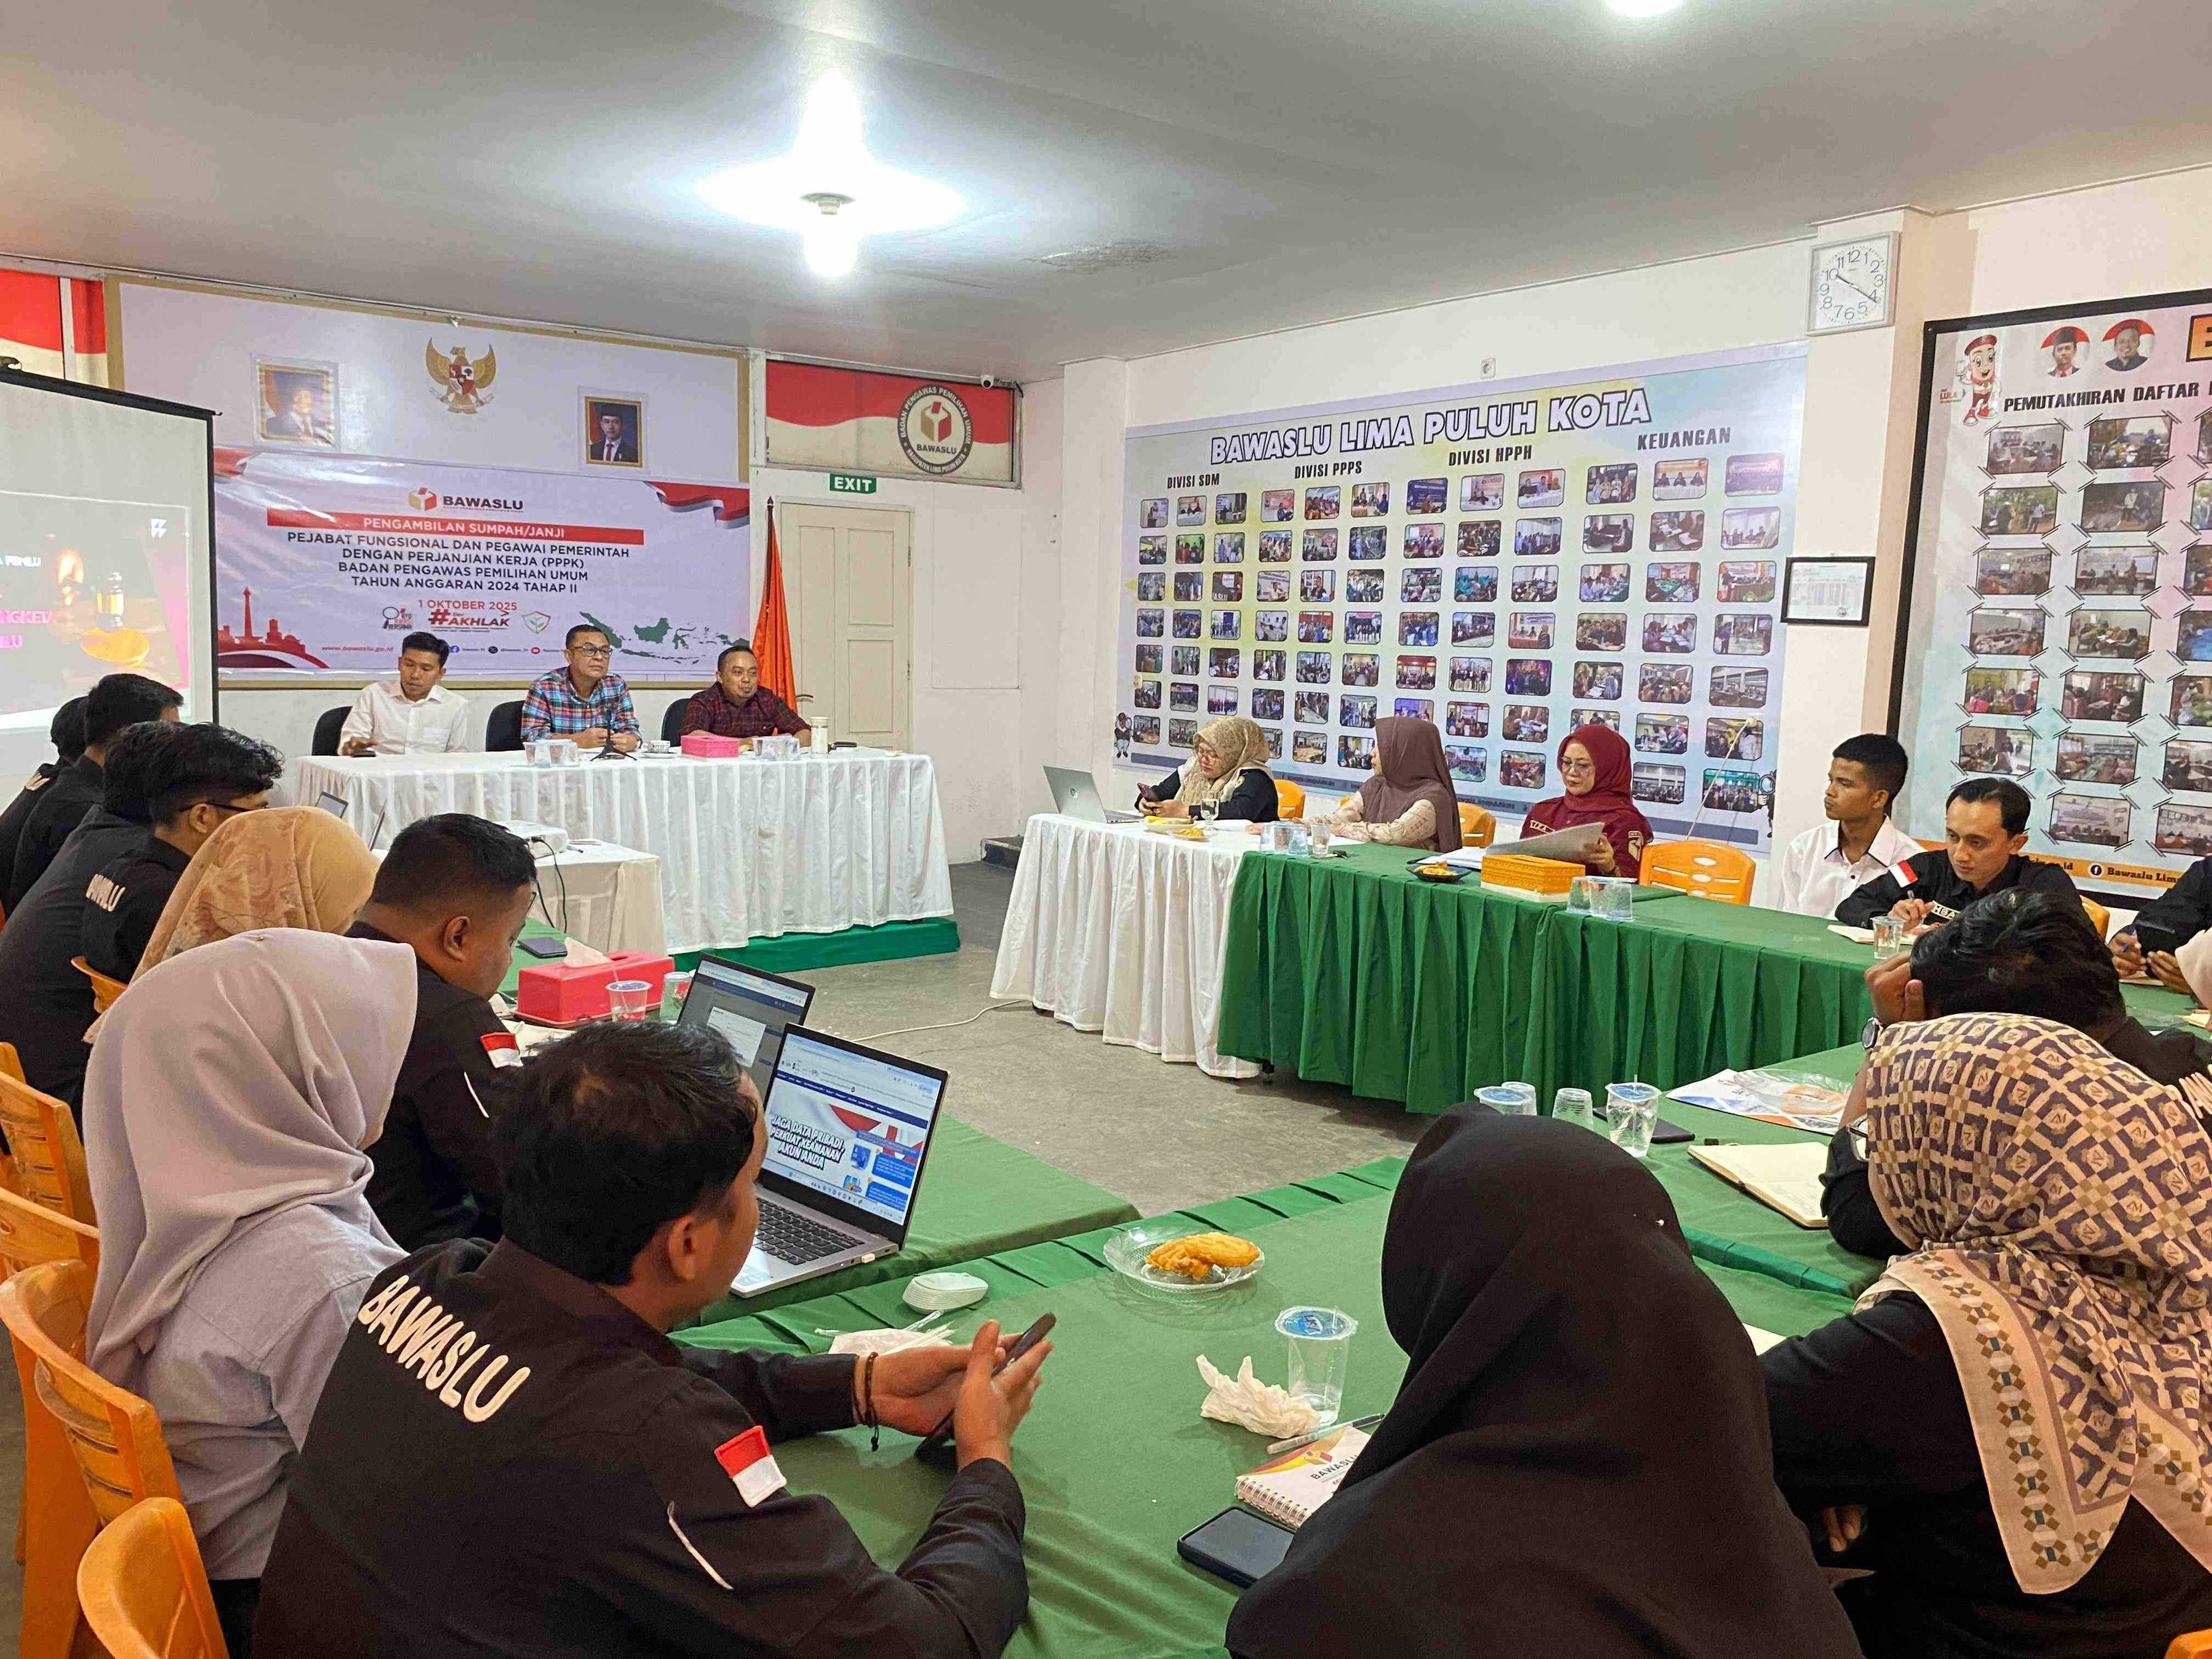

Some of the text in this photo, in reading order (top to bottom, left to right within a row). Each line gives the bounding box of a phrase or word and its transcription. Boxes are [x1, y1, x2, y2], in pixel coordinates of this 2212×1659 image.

[1837, 256, 1844, 269] 11
[1848, 250, 1860, 263] 12
[1865, 252, 1868, 264] 1
[1826, 268, 1839, 281] 10
[1870, 260, 1880, 273] 2
[1874, 274, 1883, 287] 3
[1819, 283, 1830, 296] 9
[1822, 297, 1832, 309] 8
[1858, 301, 1868, 314] 5
[1834, 305, 1843, 318] 7
[1844, 307, 1855, 320] 6
[2004, 388, 2125, 412] PEMUTAKHIRAN
[2133, 382, 2199, 401] DAFTAR
[1210, 387, 1652, 465] BAWASLU LIMA PULUH KOTA
[1637, 426, 1731, 450] KEUANGAN
[917, 444, 957, 454] BAWASLU
[1448, 445, 1533, 466] DIVISI HPPH
[1295, 460, 1363, 479] DIVISI PPPS
[834, 476, 873, 492] EXIT
[1167, 473, 1220, 489] DIVISI SDM
[443, 495, 524, 510] BAWASLU
[363, 517, 565, 538] PENGAMBILAN SUMPAH/JANJI
[287, 532, 629, 557] PEJABAT FUNGSIONAL DAN PEGAWAI PEMERINTAH
[342, 549, 584, 568] DENGAN PERJANJIAN KERJA (PPPK)
[338, 562, 588, 581] BADAN PENGAWAS PEMILIHAN UMUM
[352, 576, 577, 593] TAHUN ANGGARAN 2024 TAHAP II
[418, 600, 517, 610] 1 OKTOBER 2025
[2107, 867, 2178, 883] Bawaslu Lim
[770, 1125, 801, 1146] PERKUAT
[792, 1121, 812, 1139] DATA
[777, 1141, 825, 1171] AKUN ANDA
[358, 1275, 531, 1423] BAWASLU
